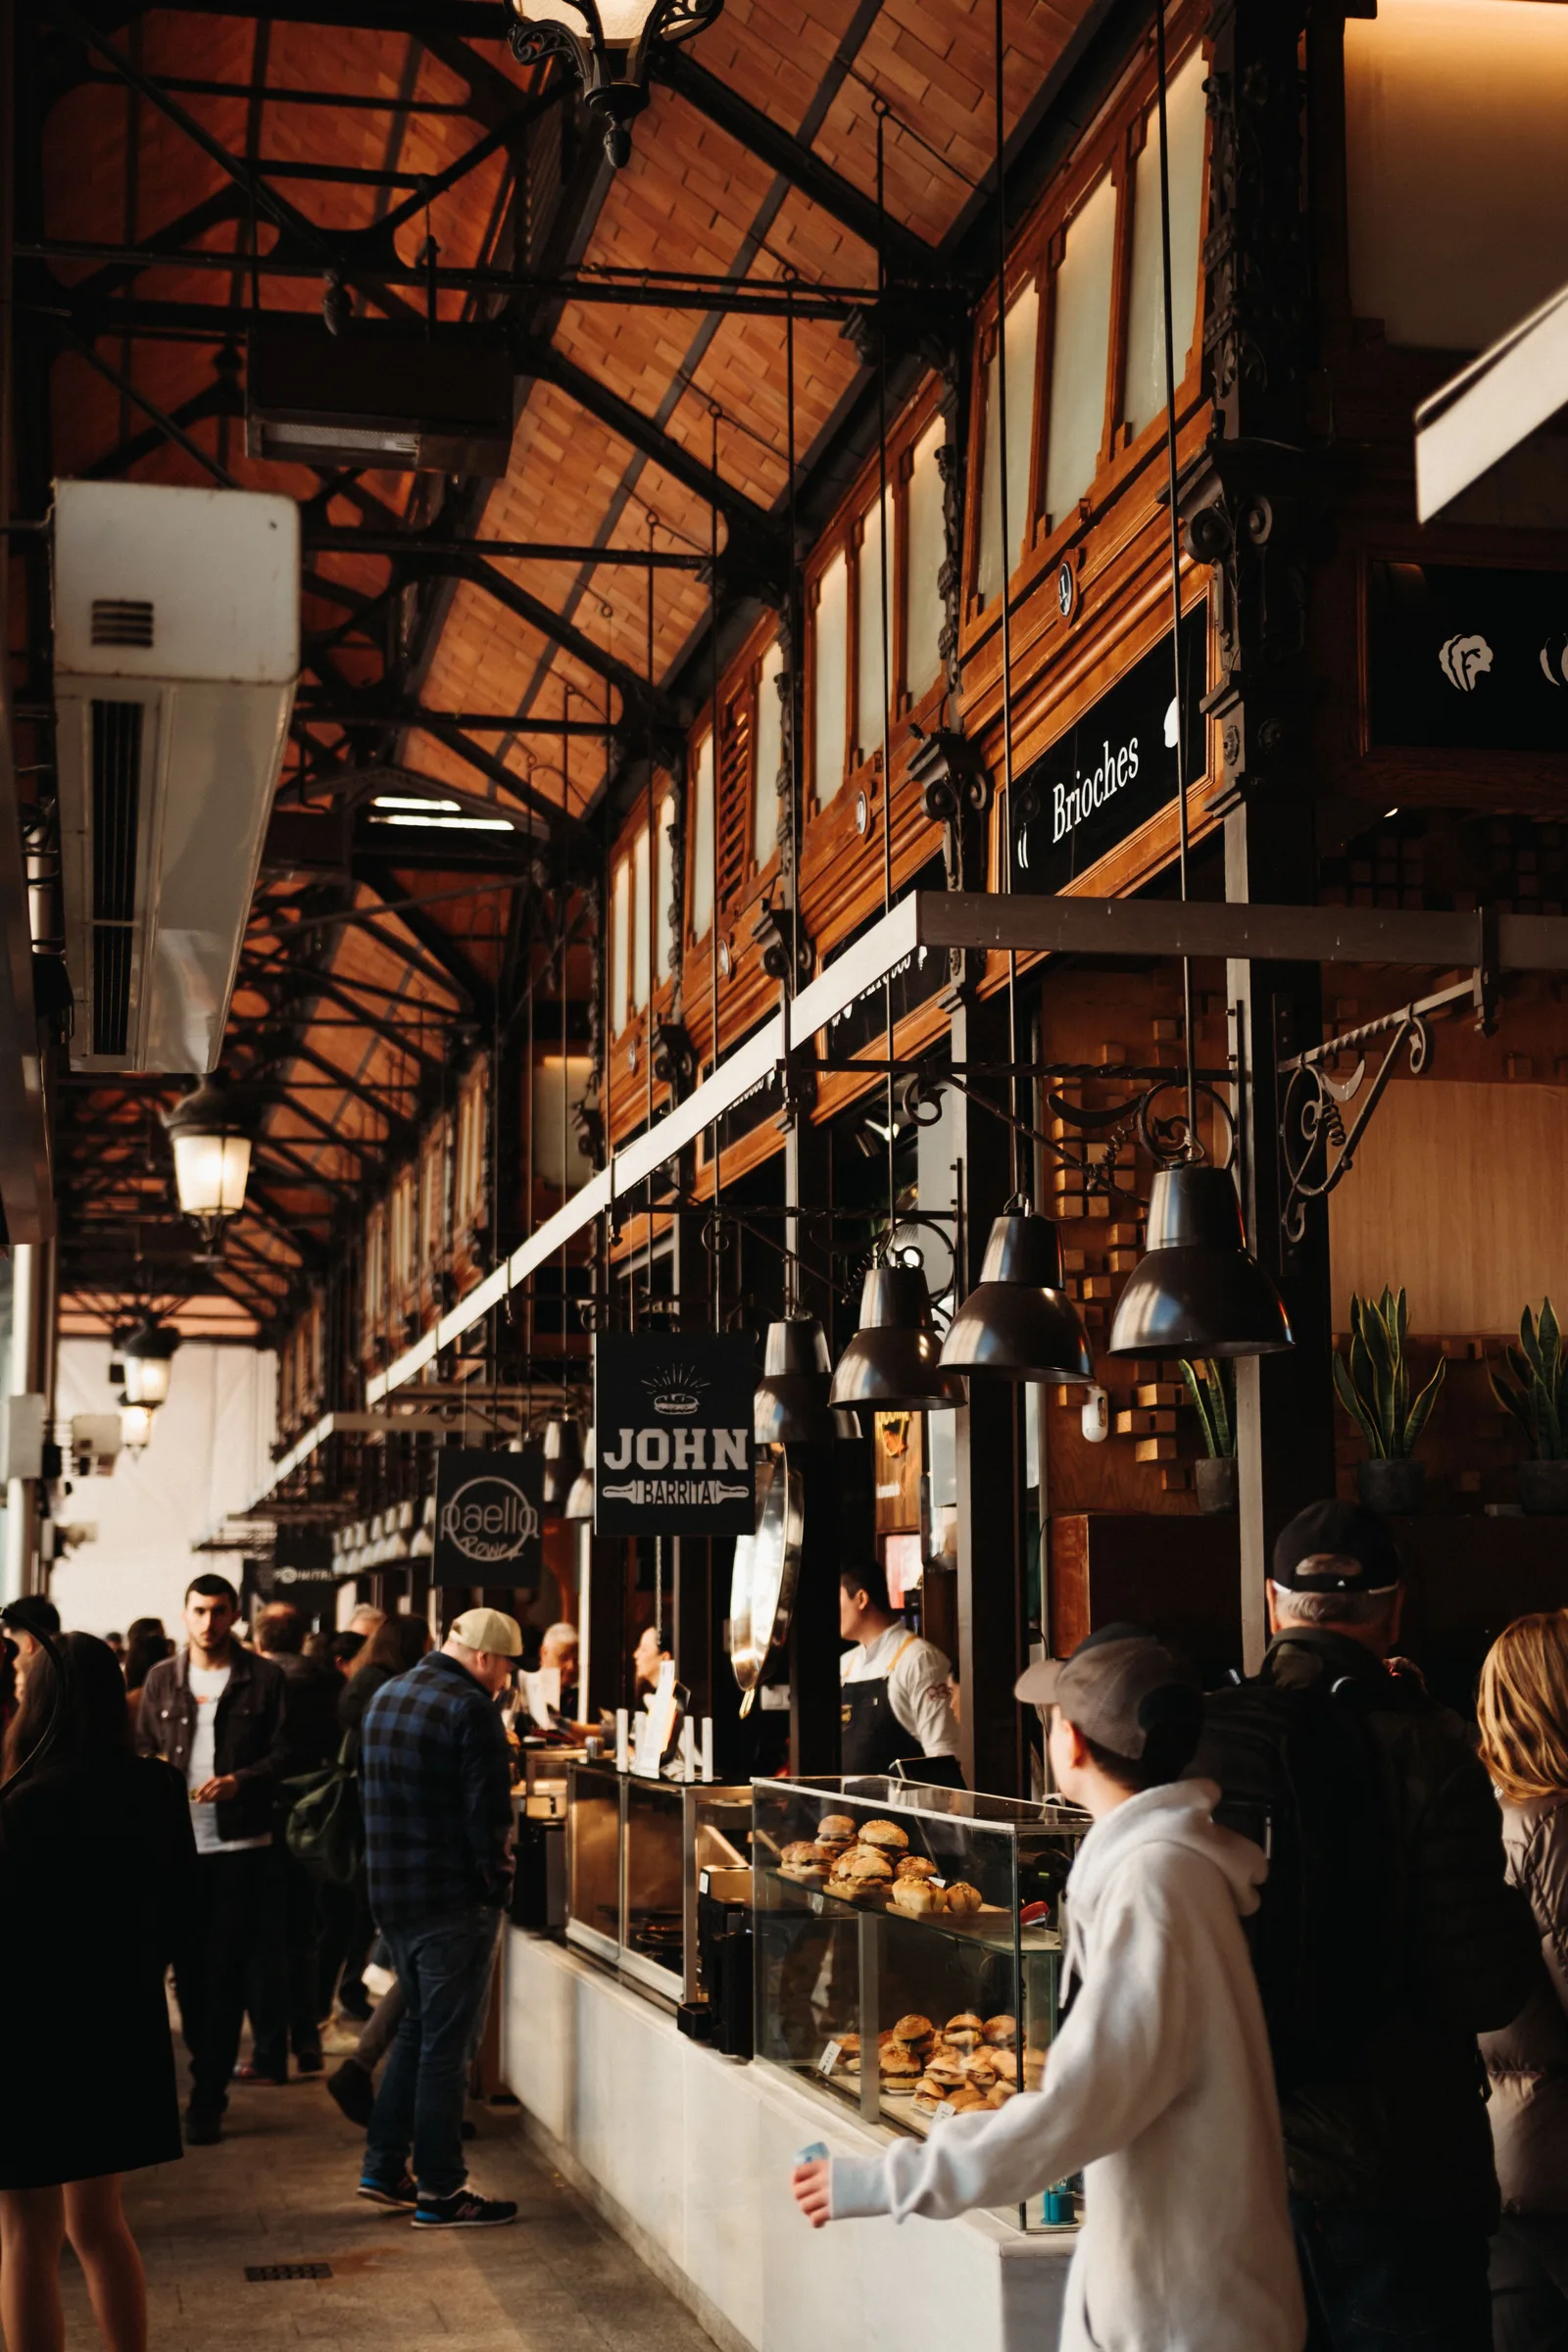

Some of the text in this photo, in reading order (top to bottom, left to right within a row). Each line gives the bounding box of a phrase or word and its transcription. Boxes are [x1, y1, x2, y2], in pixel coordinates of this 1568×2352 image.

[1053, 737, 1139, 844] Brioches
[603, 1428, 749, 1470] JOHN
[644, 1480, 712, 1504] BARRITA
[440, 1502, 541, 1542] paella
